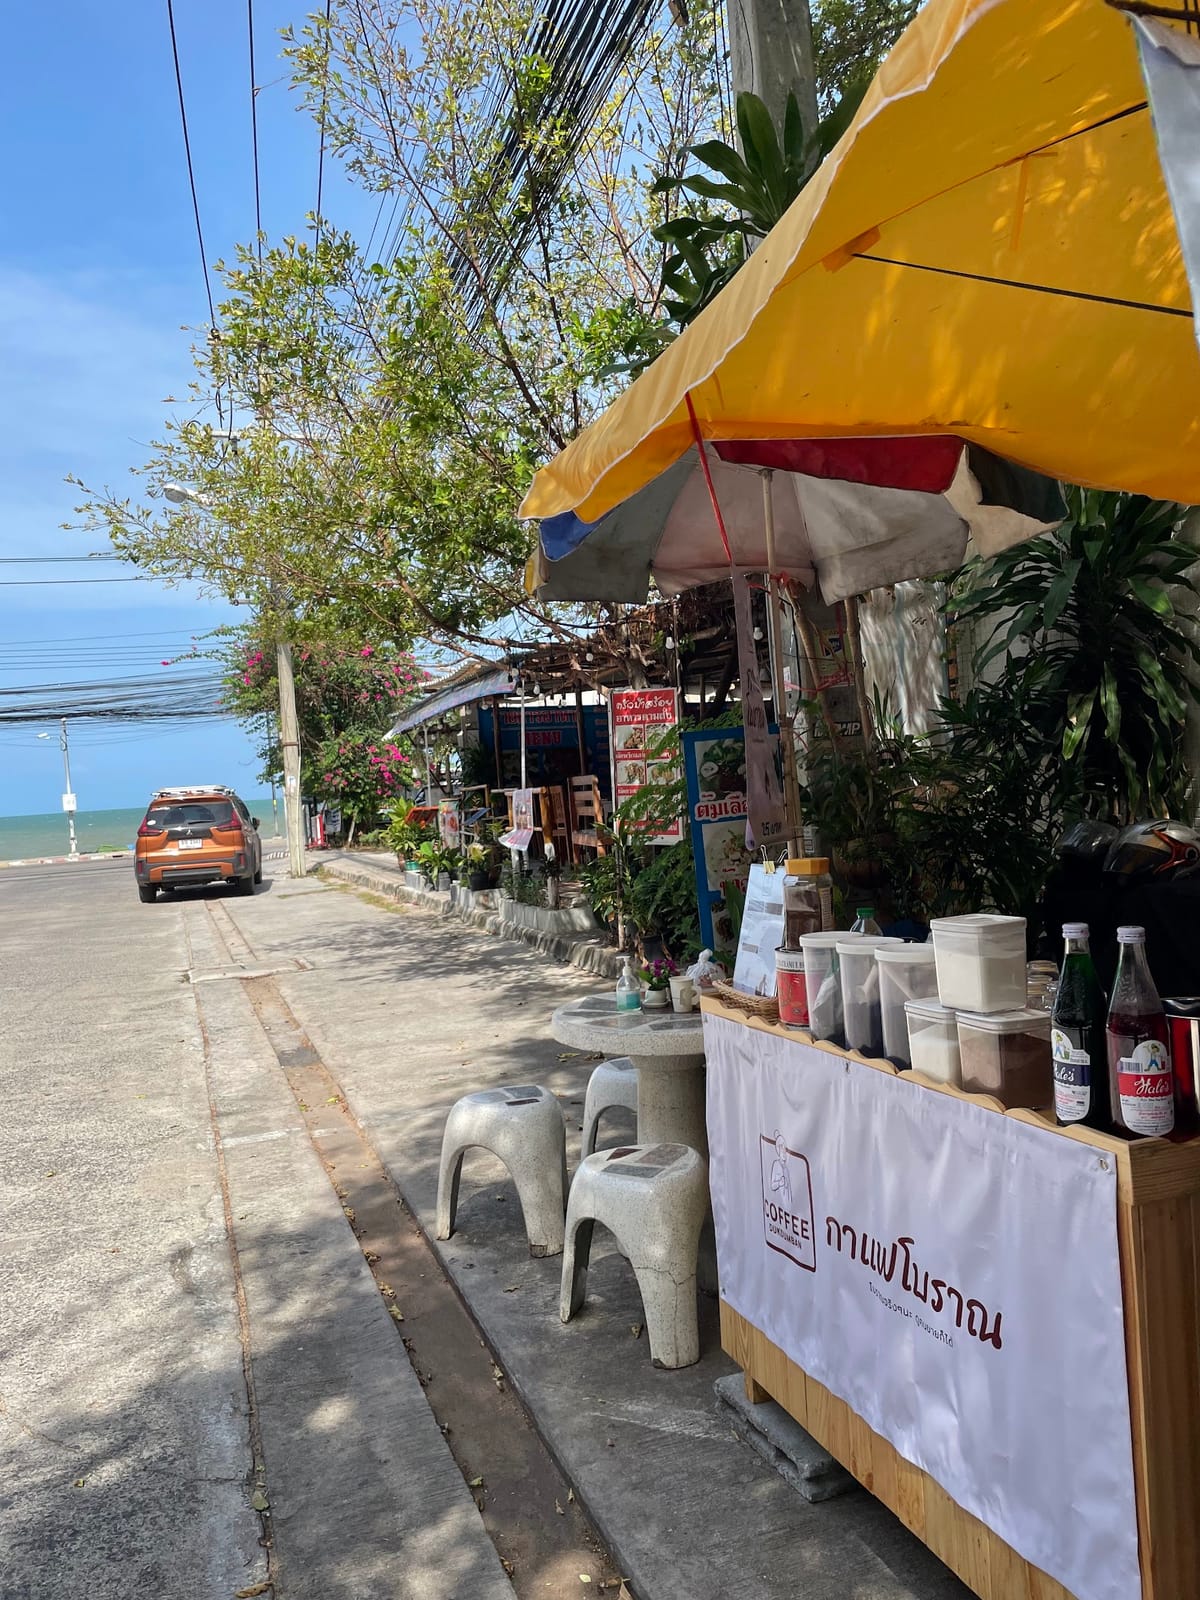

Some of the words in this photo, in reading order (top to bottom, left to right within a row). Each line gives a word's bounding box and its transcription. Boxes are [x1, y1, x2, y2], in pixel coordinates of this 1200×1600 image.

[616, 707, 672, 722] อาหารตามสั่ง
[1133, 1076, 1170, 1096] Hale's
[764, 1199, 810, 1240] COFFEE
[825, 1216, 1003, 1350] กาแฟโบราณ
